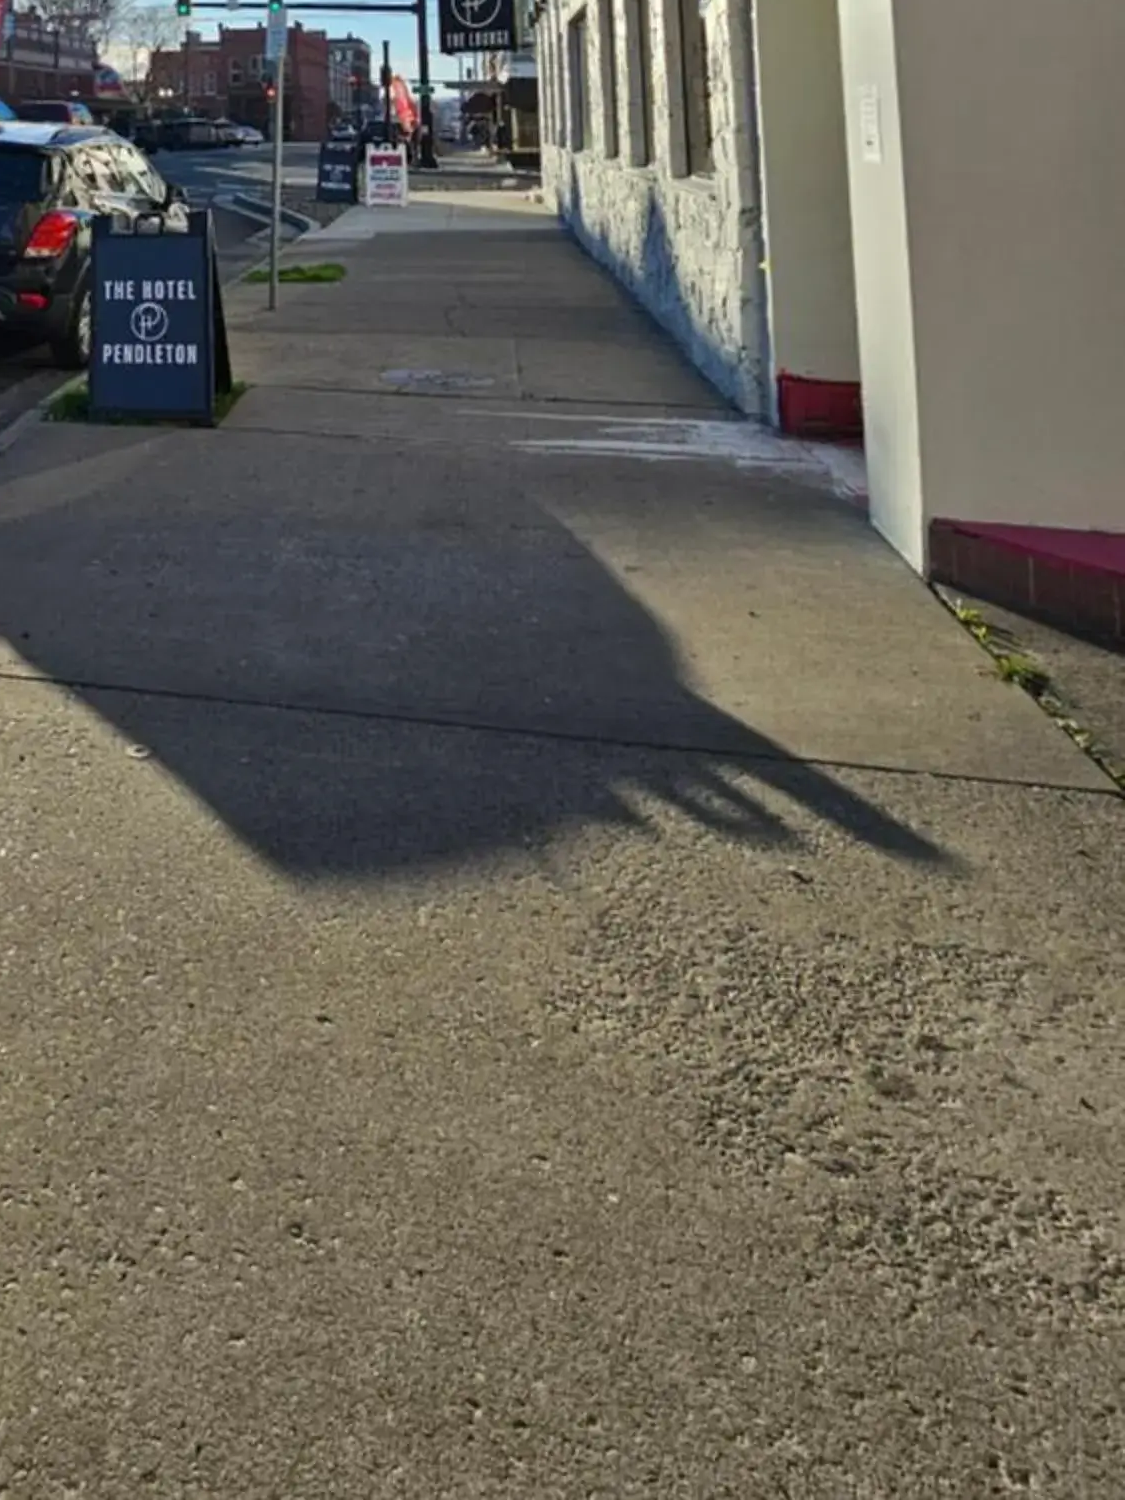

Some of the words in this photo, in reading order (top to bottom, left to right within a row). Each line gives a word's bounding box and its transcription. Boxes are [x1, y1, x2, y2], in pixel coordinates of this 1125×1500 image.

[103, 280, 135, 300] THE
[142, 279, 196, 300] HOTEL
[102, 343, 198, 364] PENDLETON
